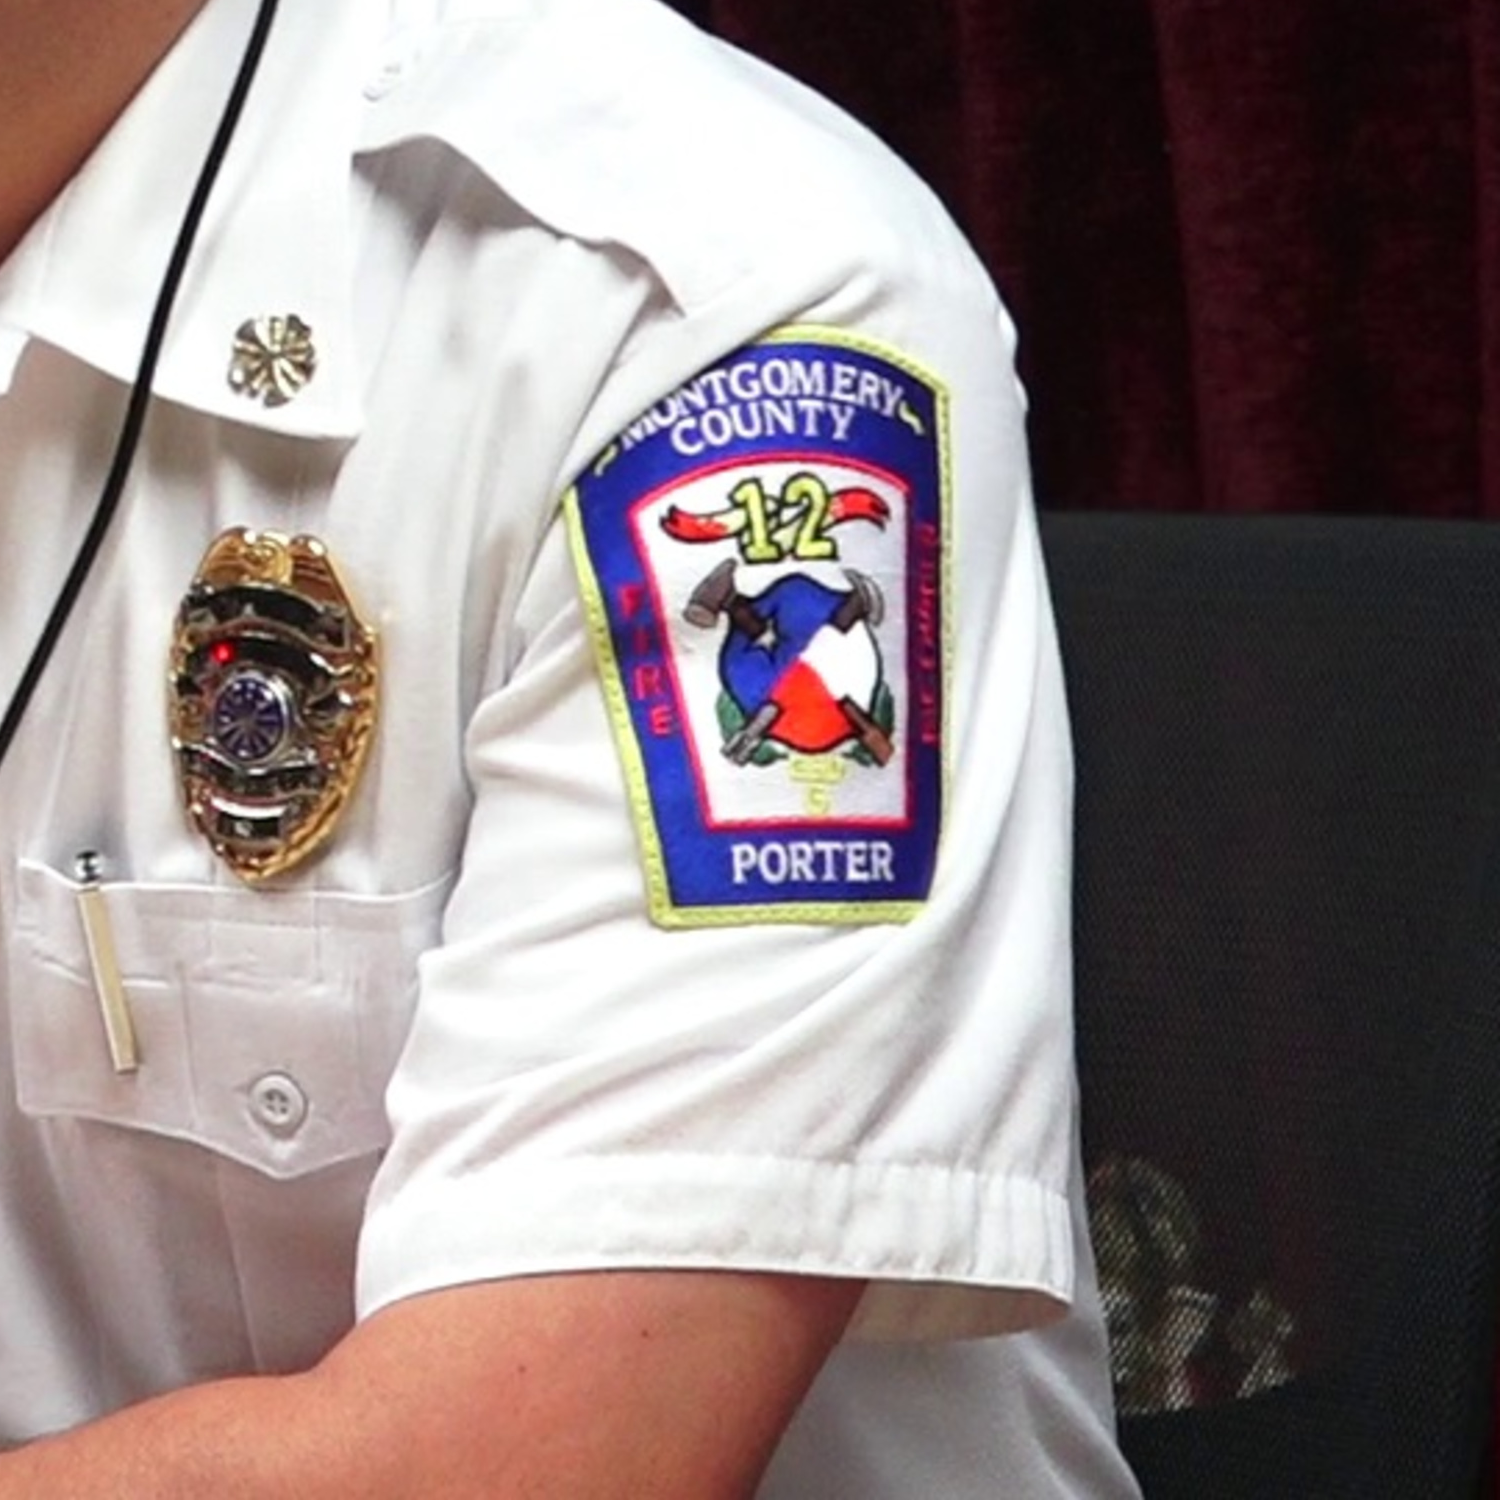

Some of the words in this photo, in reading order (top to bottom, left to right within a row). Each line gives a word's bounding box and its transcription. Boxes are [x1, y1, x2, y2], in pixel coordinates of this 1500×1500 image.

[620, 358, 902, 451] MONTGOMERY
[670, 398, 855, 456] COUNTY
[727, 472, 838, 564] 12
[617, 584, 678, 737] FIRE
[730, 840, 895, 884] PORTER
